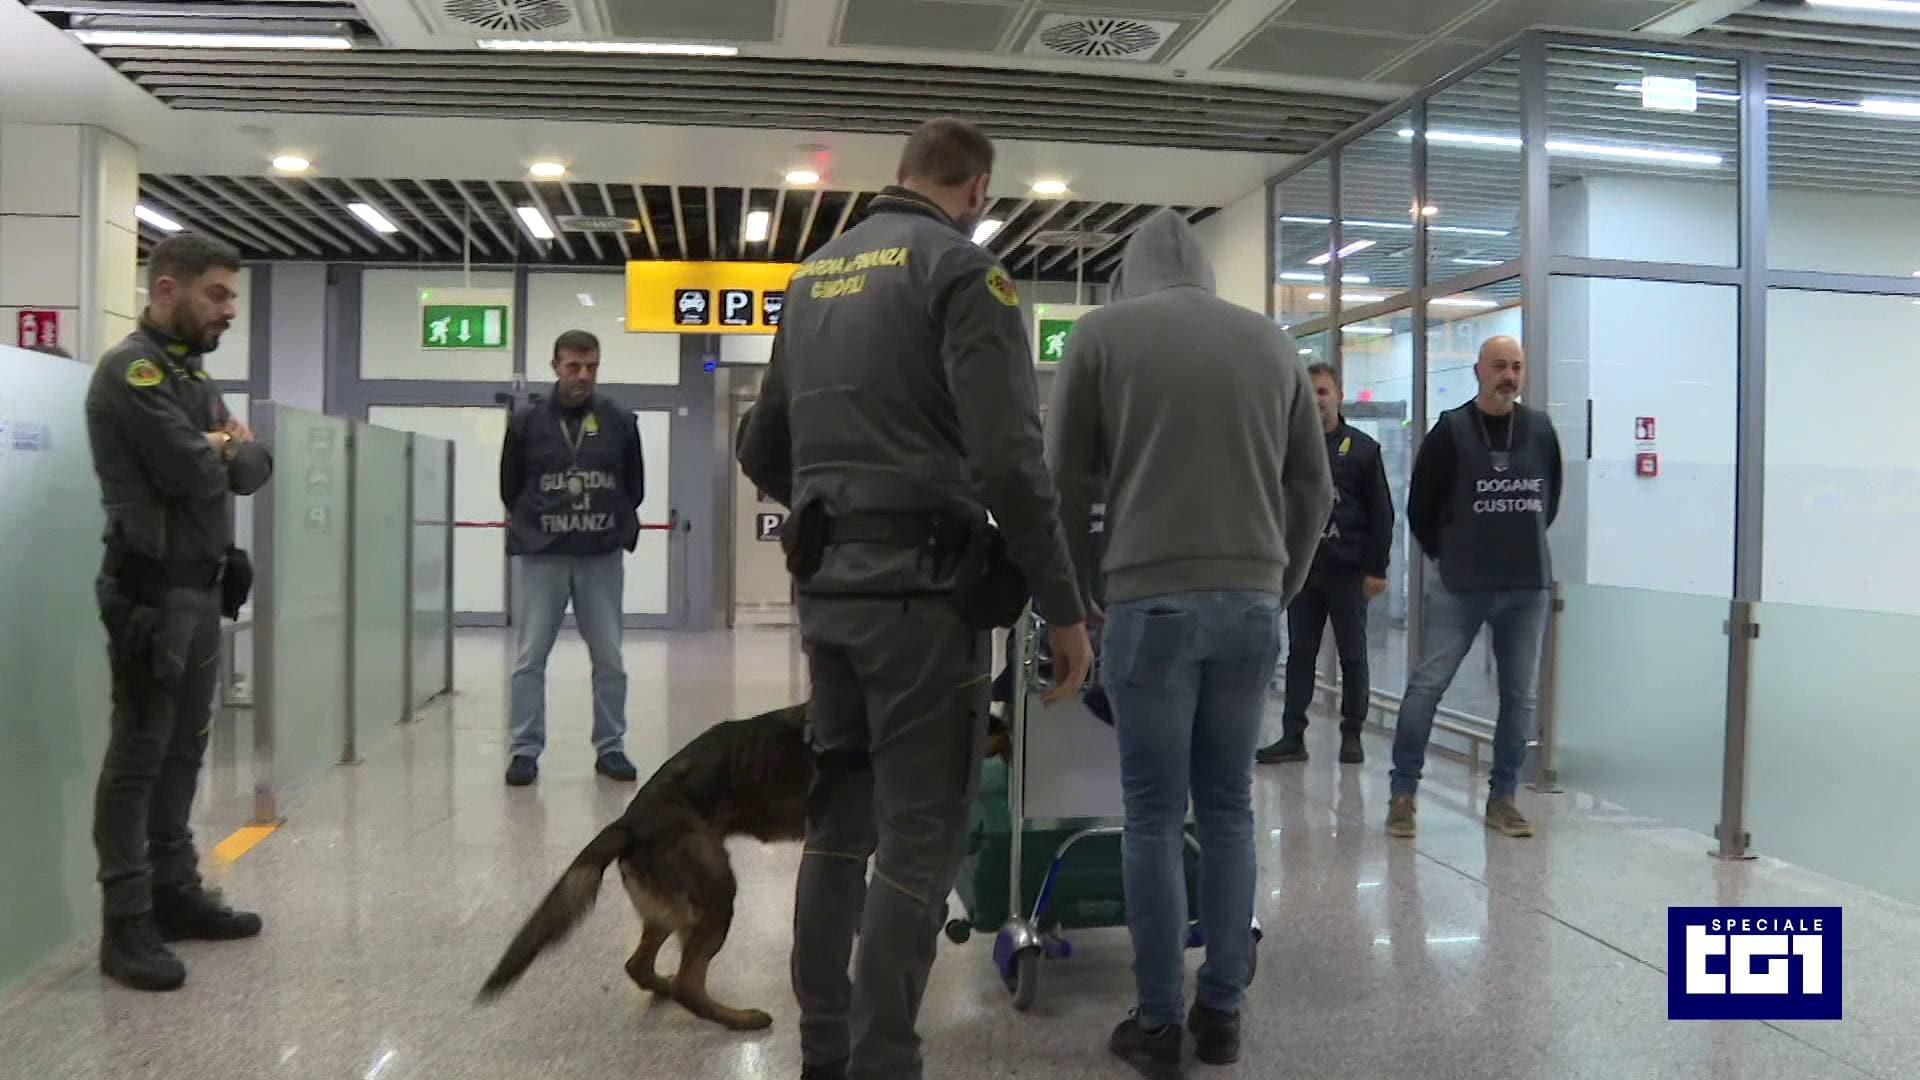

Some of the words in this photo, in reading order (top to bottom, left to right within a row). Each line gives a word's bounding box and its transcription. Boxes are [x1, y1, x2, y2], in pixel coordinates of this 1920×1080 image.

[726, 292, 748, 319] P
[1476, 478, 1544, 493] DOGANE
[540, 512, 616, 533] FINANZA
